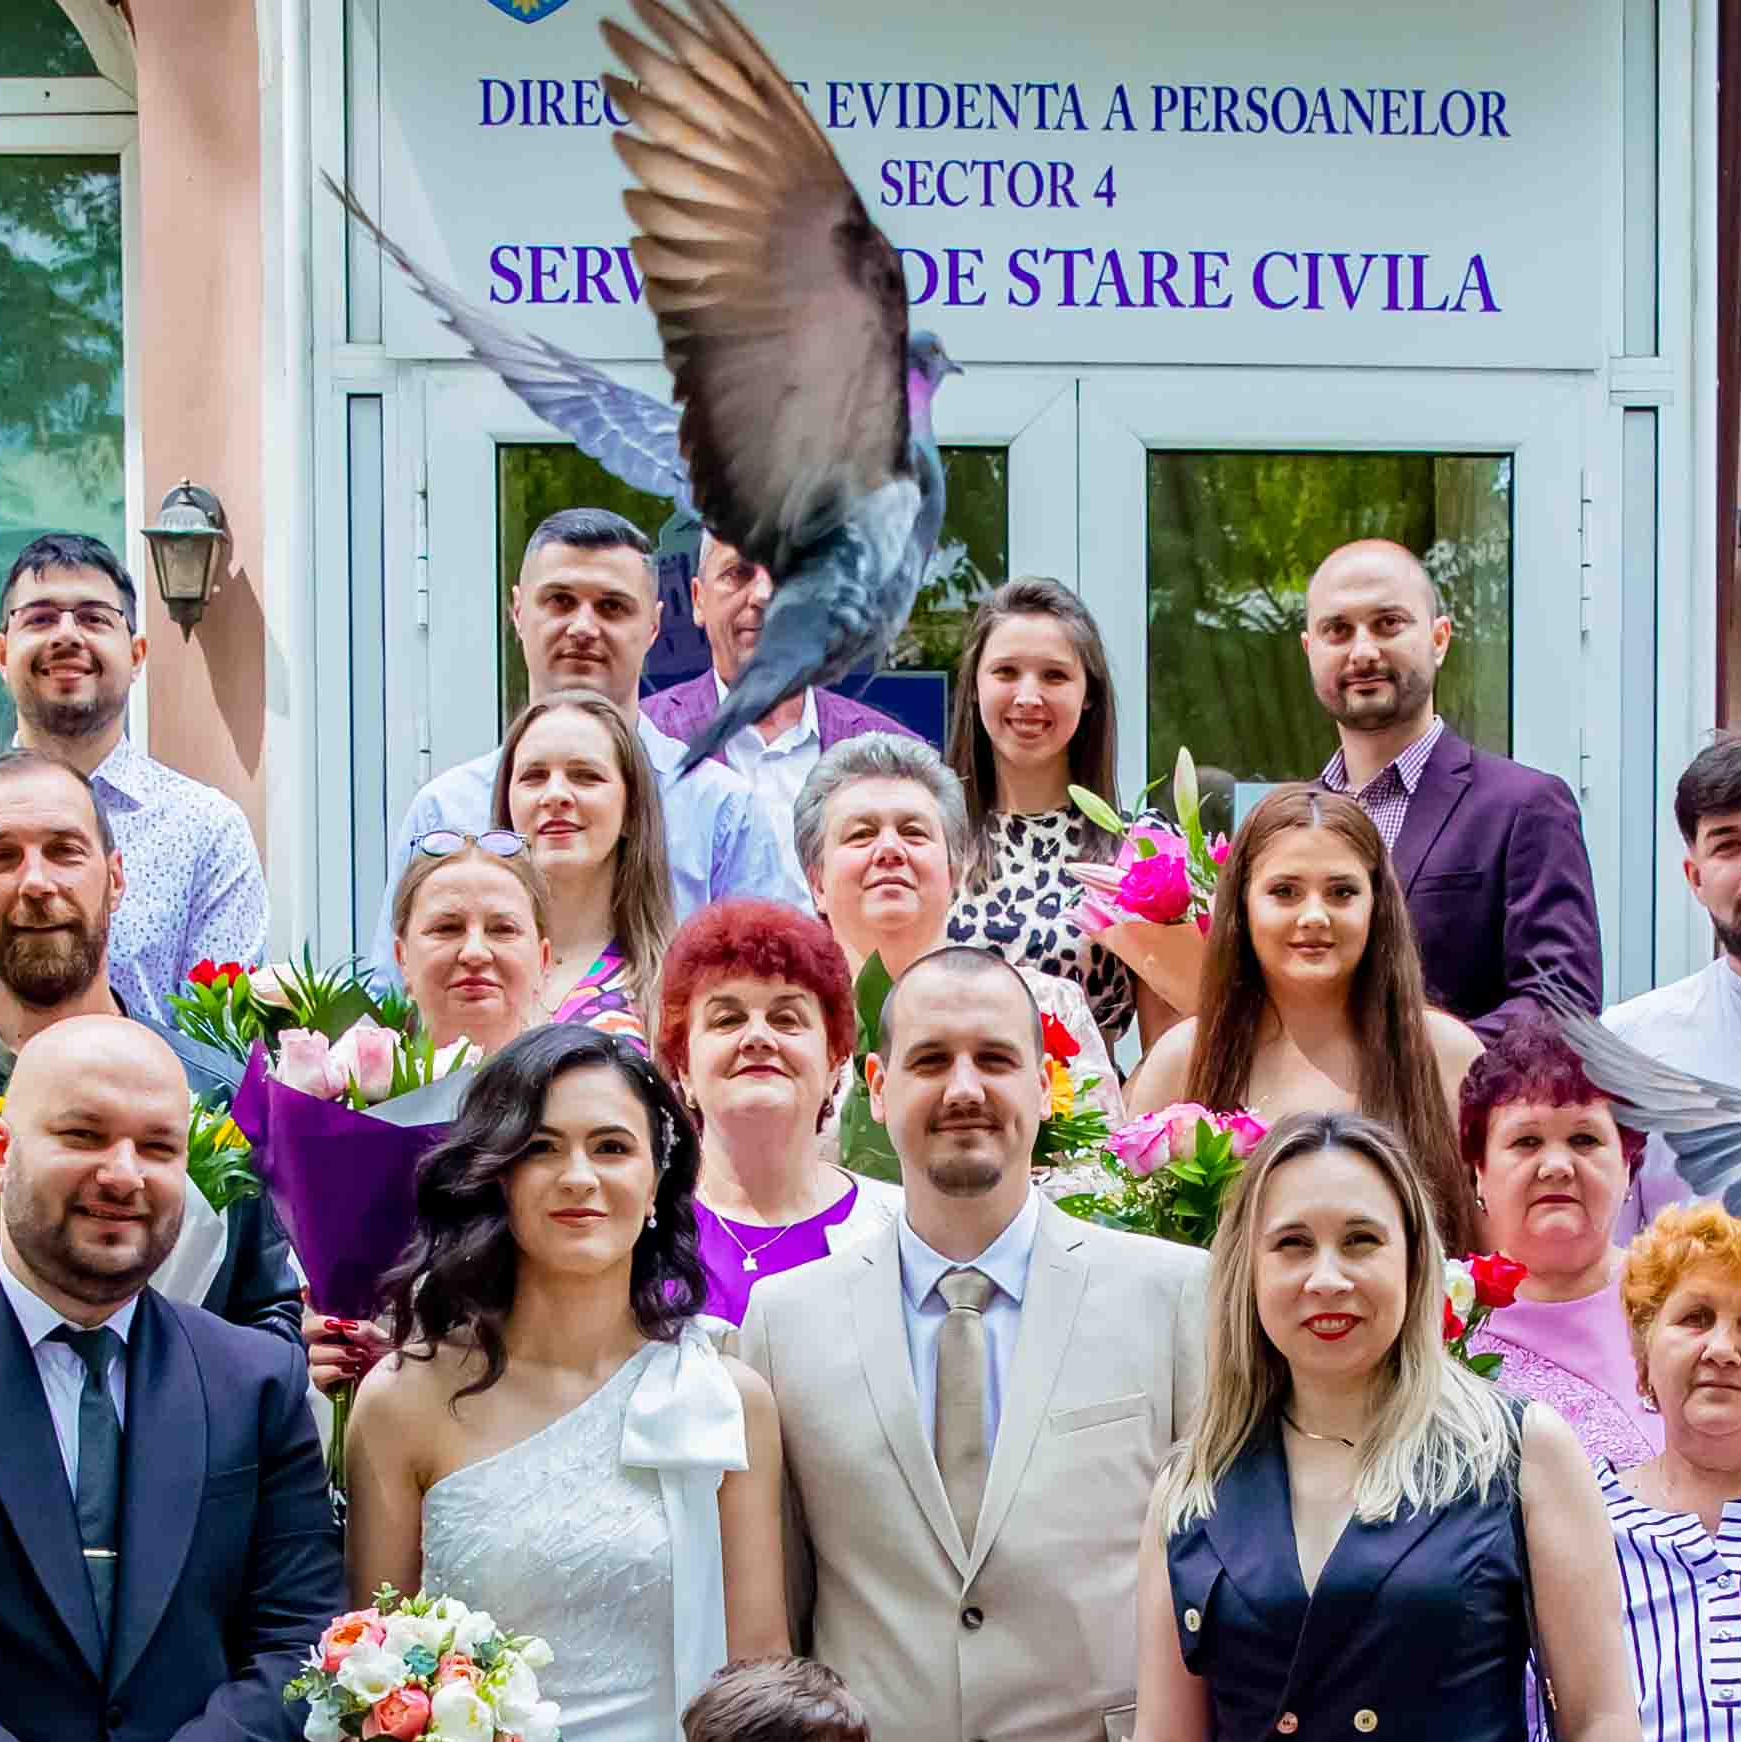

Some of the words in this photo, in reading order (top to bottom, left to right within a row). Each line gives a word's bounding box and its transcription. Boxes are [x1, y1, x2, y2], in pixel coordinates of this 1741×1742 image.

[478, 79, 638, 127] DIREC
[826, 82, 1089, 131] EVIDENTA
[1102, 83, 1138, 131] A
[1150, 85, 1511, 137] PERSOANELOR
[880, 160, 1080, 208] SECTOR
[1093, 165, 1117, 208] 4
[895, 248, 987, 307] DE
[1008, 248, 1234, 309] STARE
[1252, 251, 1503, 313] CIVILA
